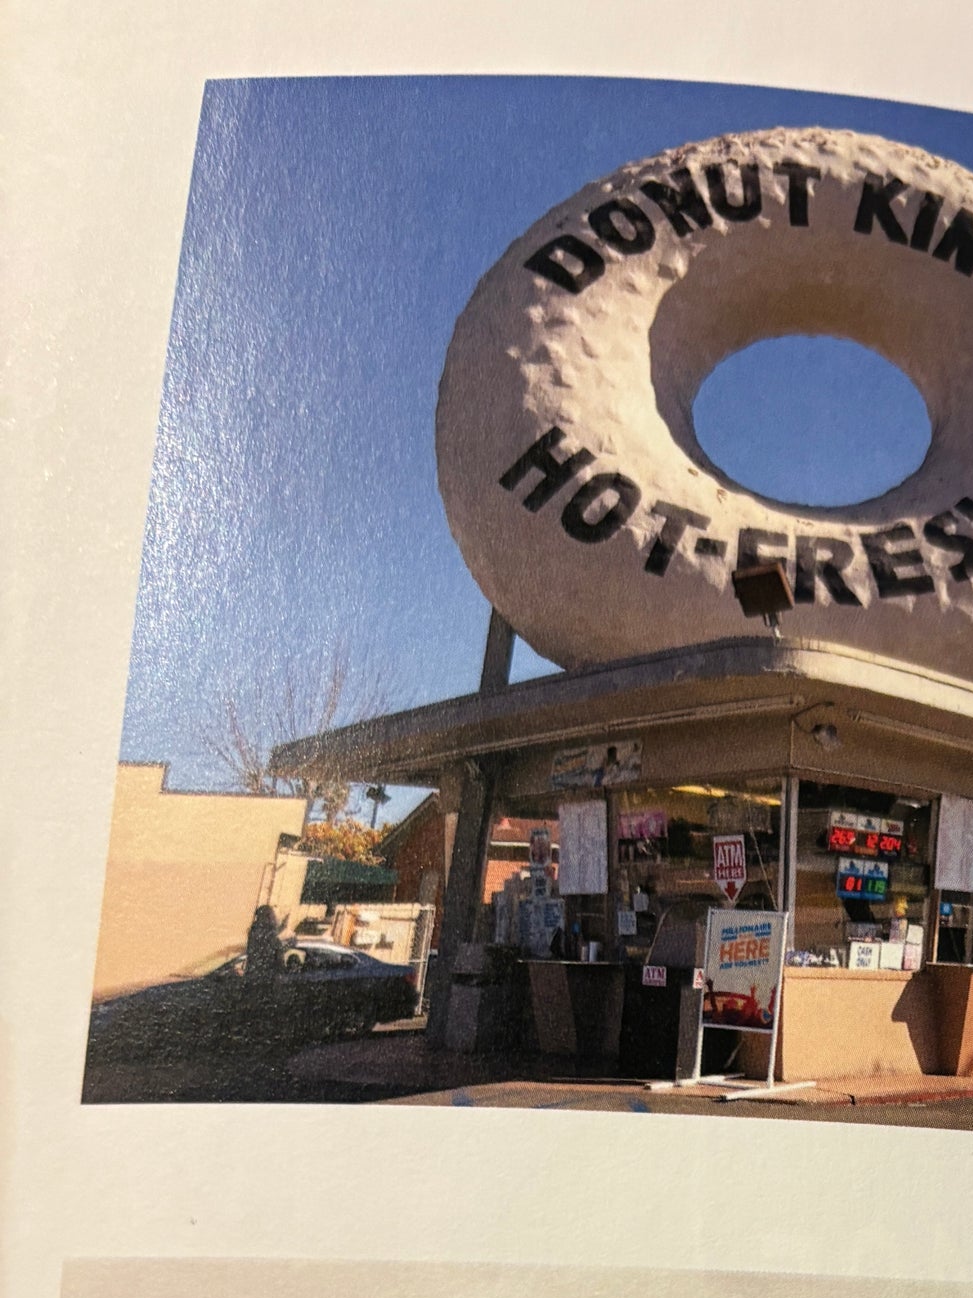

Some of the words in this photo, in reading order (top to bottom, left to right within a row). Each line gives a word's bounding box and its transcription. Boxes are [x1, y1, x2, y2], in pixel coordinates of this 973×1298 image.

[522, 160, 821, 296] DONUT
[716, 844, 743, 868] ATM
[717, 867, 743, 880] HERE
[719, 937, 770, 963] HERE
